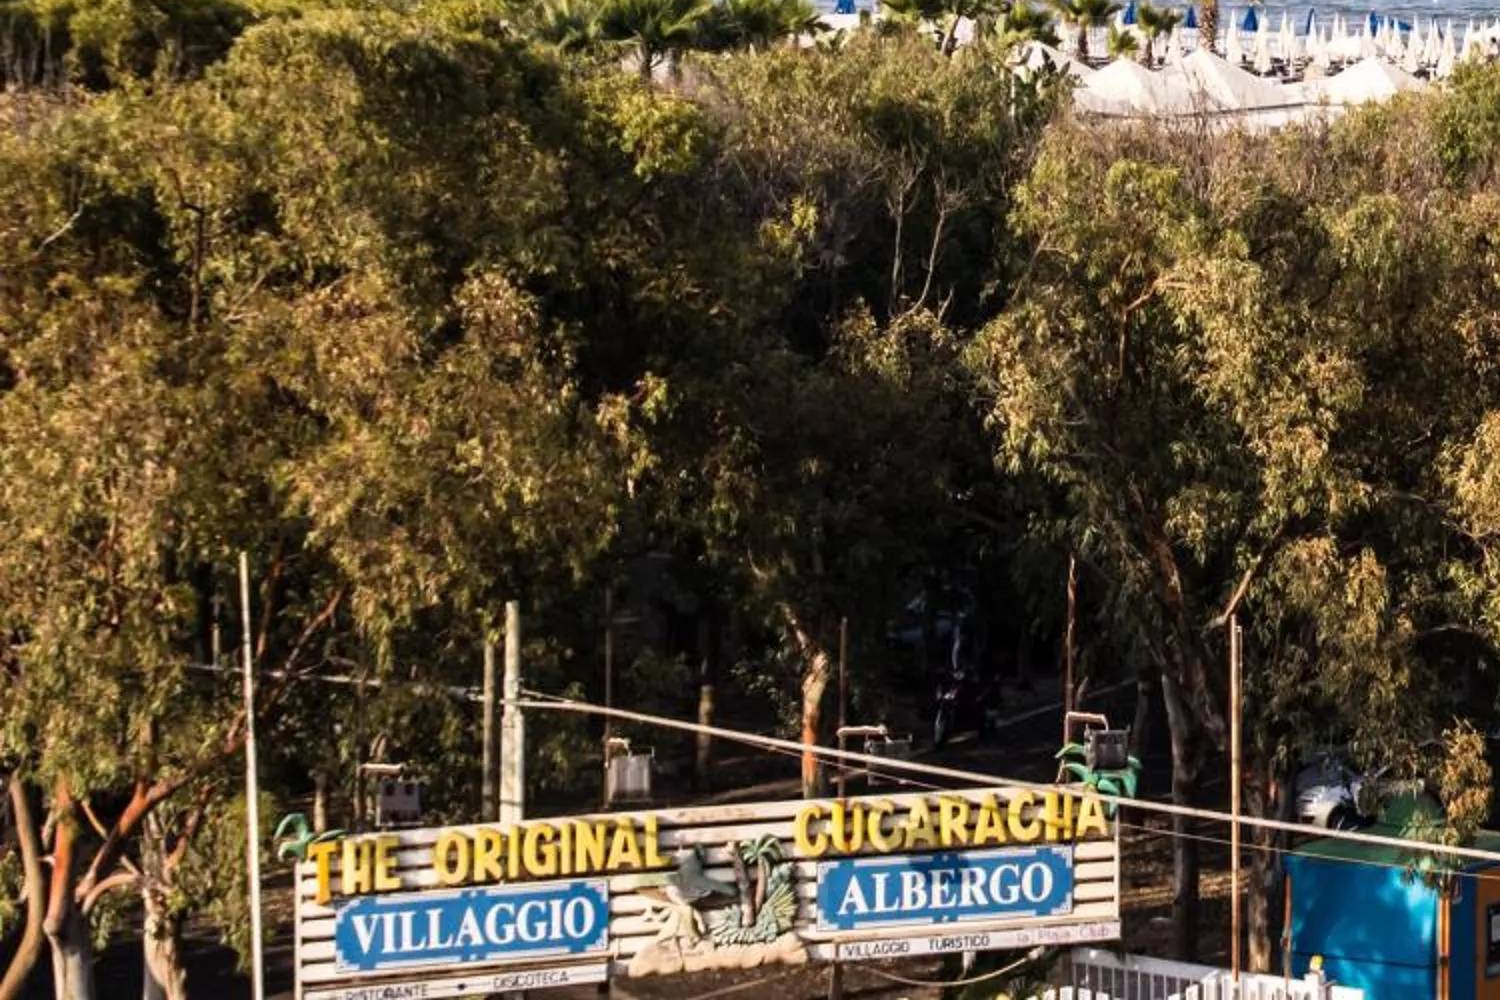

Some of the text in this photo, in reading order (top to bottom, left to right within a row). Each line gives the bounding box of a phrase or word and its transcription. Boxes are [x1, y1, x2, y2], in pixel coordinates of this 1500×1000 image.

[308, 790, 1107, 905] THE ORIGINAL CUCARACHA
[838, 862, 1053, 916] ALBERGO
[352, 896, 595, 955] VILLAGGIO
[844, 935, 991, 957] VILLAGGIO TURISTICO
[493, 971, 569, 988] DISCOTECA
